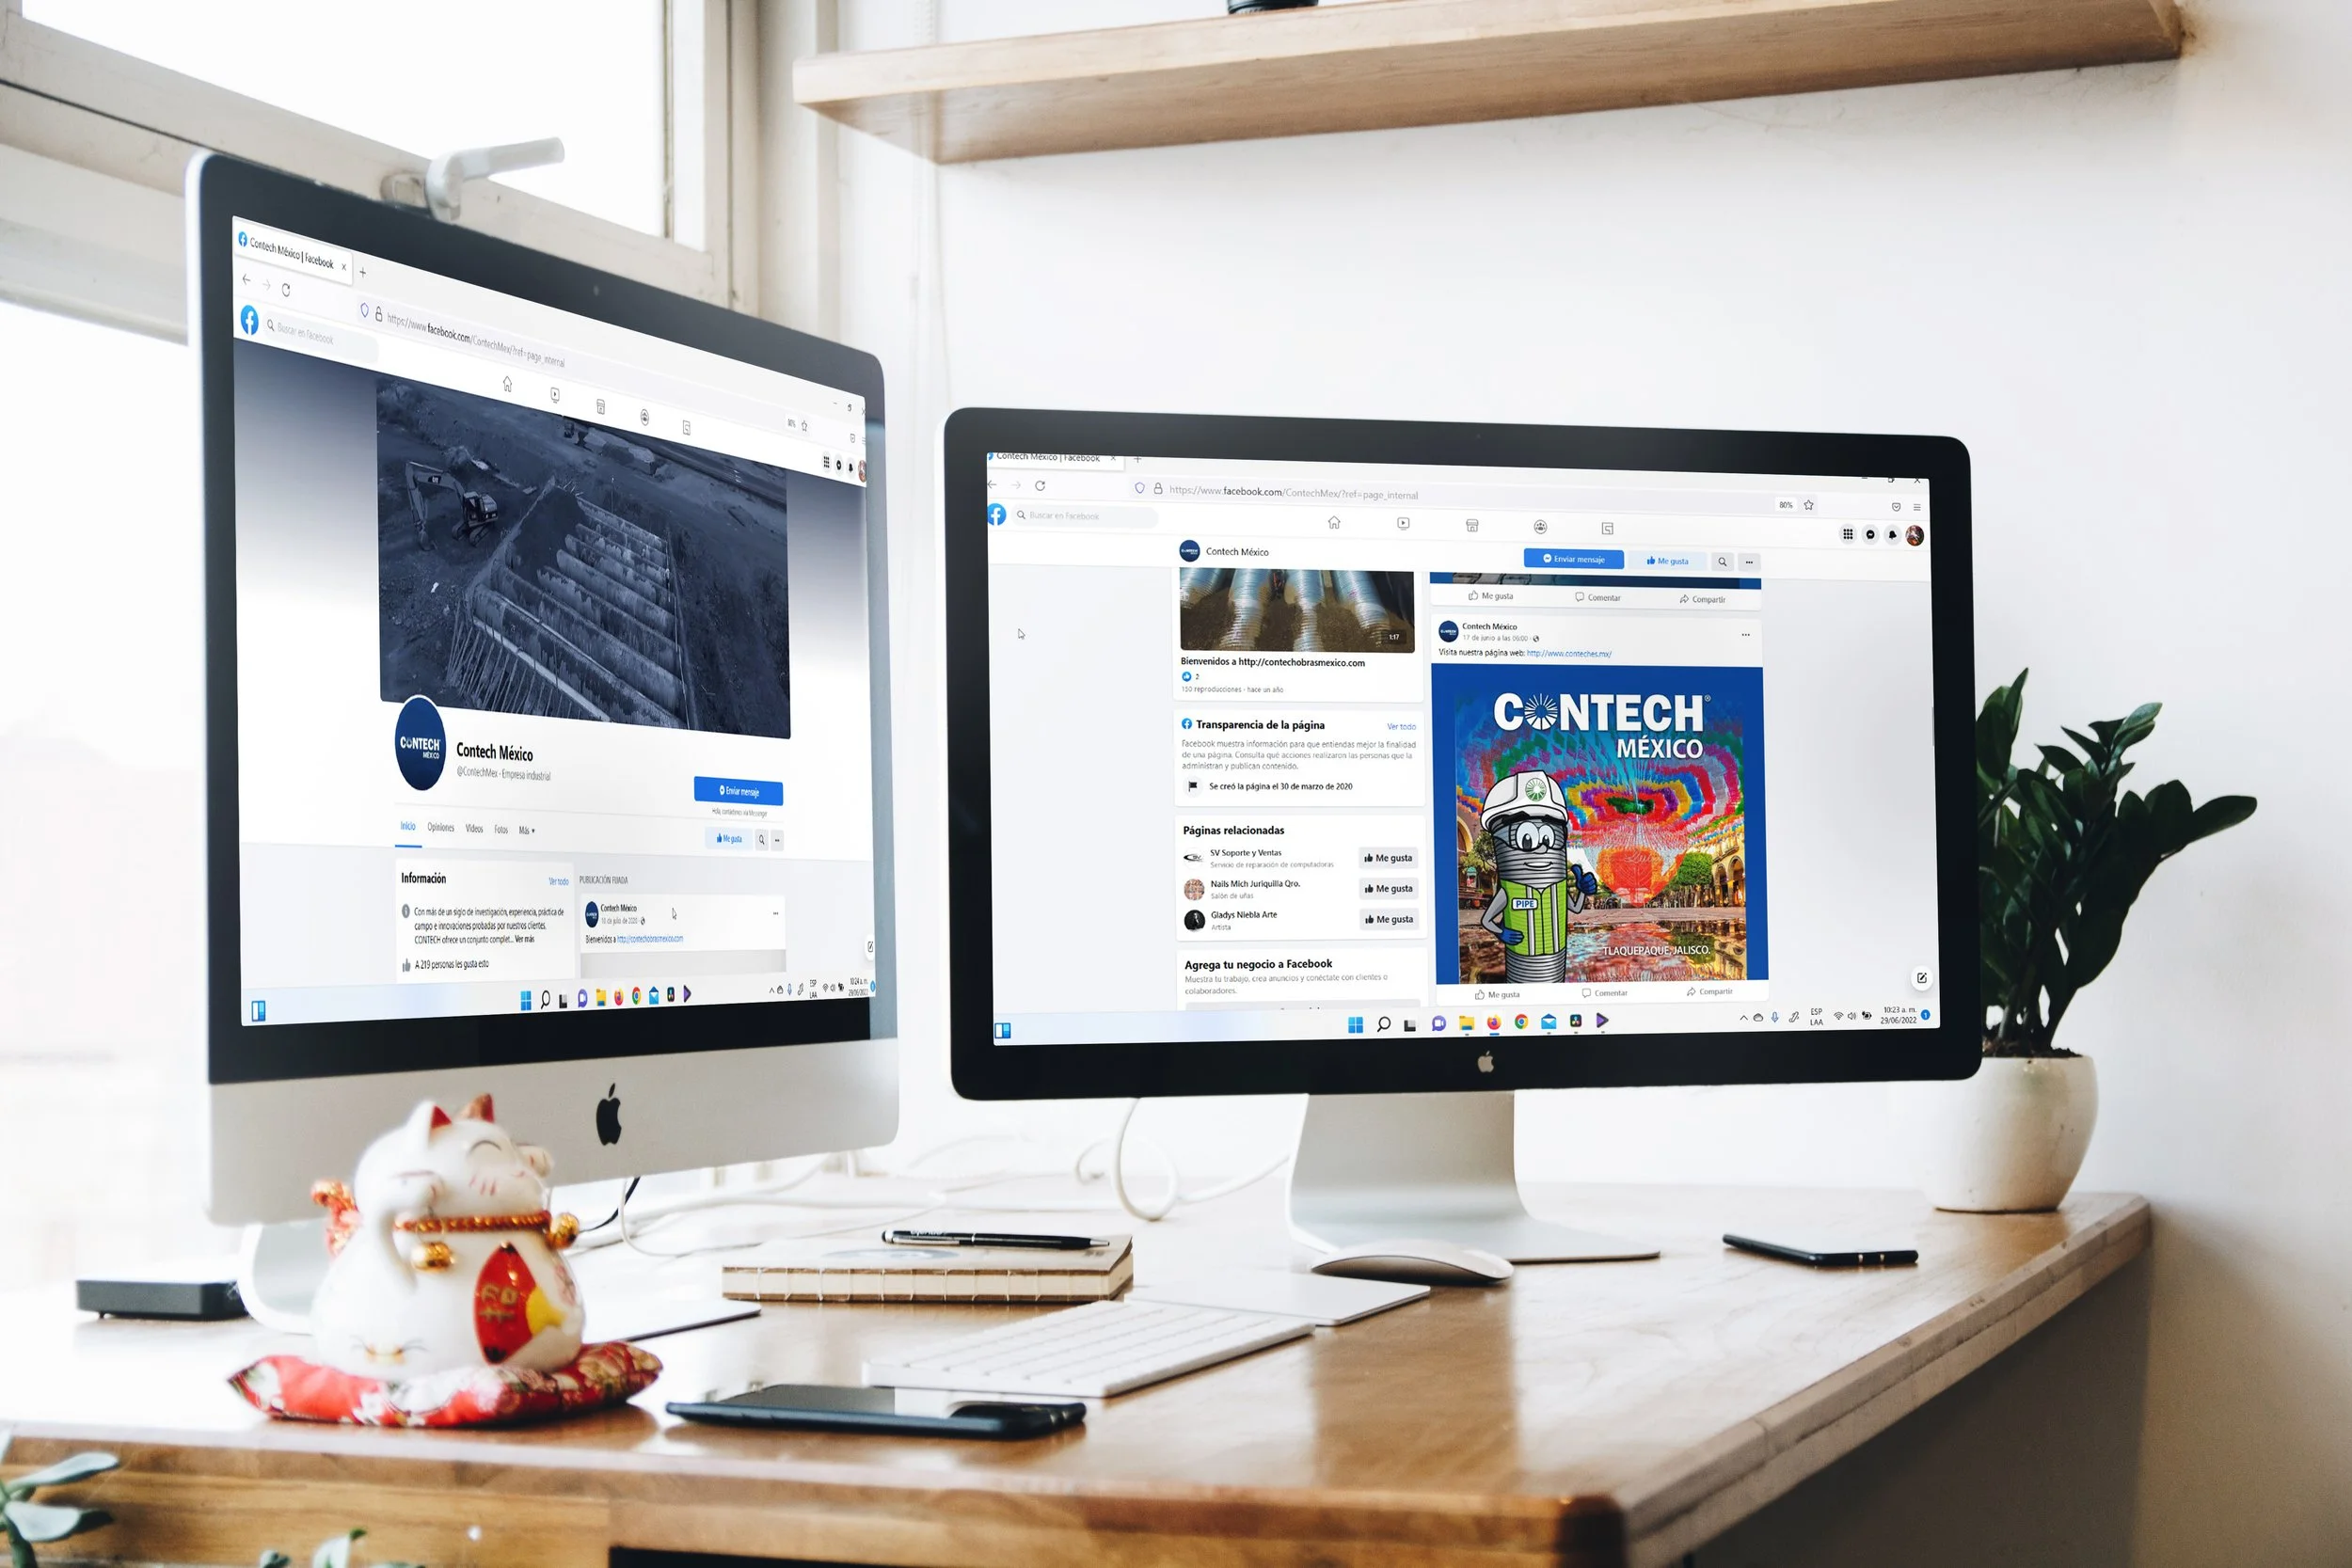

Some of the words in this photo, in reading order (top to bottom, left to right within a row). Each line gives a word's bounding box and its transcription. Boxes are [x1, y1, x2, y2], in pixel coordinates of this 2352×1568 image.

[250, 237, 277, 253] Contech
[278, 245, 300, 260] México
[305, 252, 334, 269] Facebook
[1206, 547, 1239, 556] Contech
[1241, 547, 1269, 557] México
[1577, 555, 1605, 564] mensaje
[1482, 592, 1494, 600] Me
[1494, 593, 1514, 602] gusta
[1588, 594, 1621, 602] Comentar
[1692, 595, 1725, 605] Compartir
[1485, 648, 1508, 658] página
[1181, 657, 1230, 666] Bienvenidos
[1238, 657, 1365, 668] http://contechobrasmexico.com
[1196, 720, 1263, 732] Transparencia
[1266, 720, 1279, 729] de
[1281, 720, 1290, 730] la
[1293, 720, 1325, 733] página
[1182, 739, 1216, 748] Facebook
[1246, 739, 1288, 748] información
[1306, 741, 1320, 750] que
[1321, 740, 1355, 749] entiendas
[1356, 741, 1376, 751] mejor
[1386, 740, 1417, 749] finalidad
[1617, 735, 1704, 759] MÉXICO
[456, 742, 497, 759] Contech
[500, 745, 533, 762] México
[1246, 783, 1271, 792] página
[1184, 825, 1221, 837] Páginas
[1224, 825, 1285, 835] relacionadas
[1221, 849, 1250, 858] Soporte
[1391, 854, 1412, 863] gusta
[402, 872, 446, 884] Información
[1250, 879, 1283, 889] Juriquilla
[1376, 884, 1390, 893] Me
[1391, 885, 1413, 895] gusta
[1516, 900, 1534, 909] PIPE
[1211, 911, 1235, 921] Gladys
[1236, 911, 1261, 919] Niebla
[1376, 915, 1390, 924] Me
[1391, 915, 1413, 926] gusta
[1603, 946, 1671, 957] TLAQUEPAQUE,
[1672, 945, 1711, 956] JALISCO.
[1184, 960, 1221, 973] Agrega
[1223, 960, 1233, 970] tu
[1236, 959, 1276, 972] negocio
[1287, 958, 1332, 969] Facebook
[1501, 991, 1520, 1000] gusta
[1699, 988, 1733, 996] Compartir
[1810, 1007, 1822, 1016] ESP
[1881, 1016, 1917, 1024] 29/06/2022
